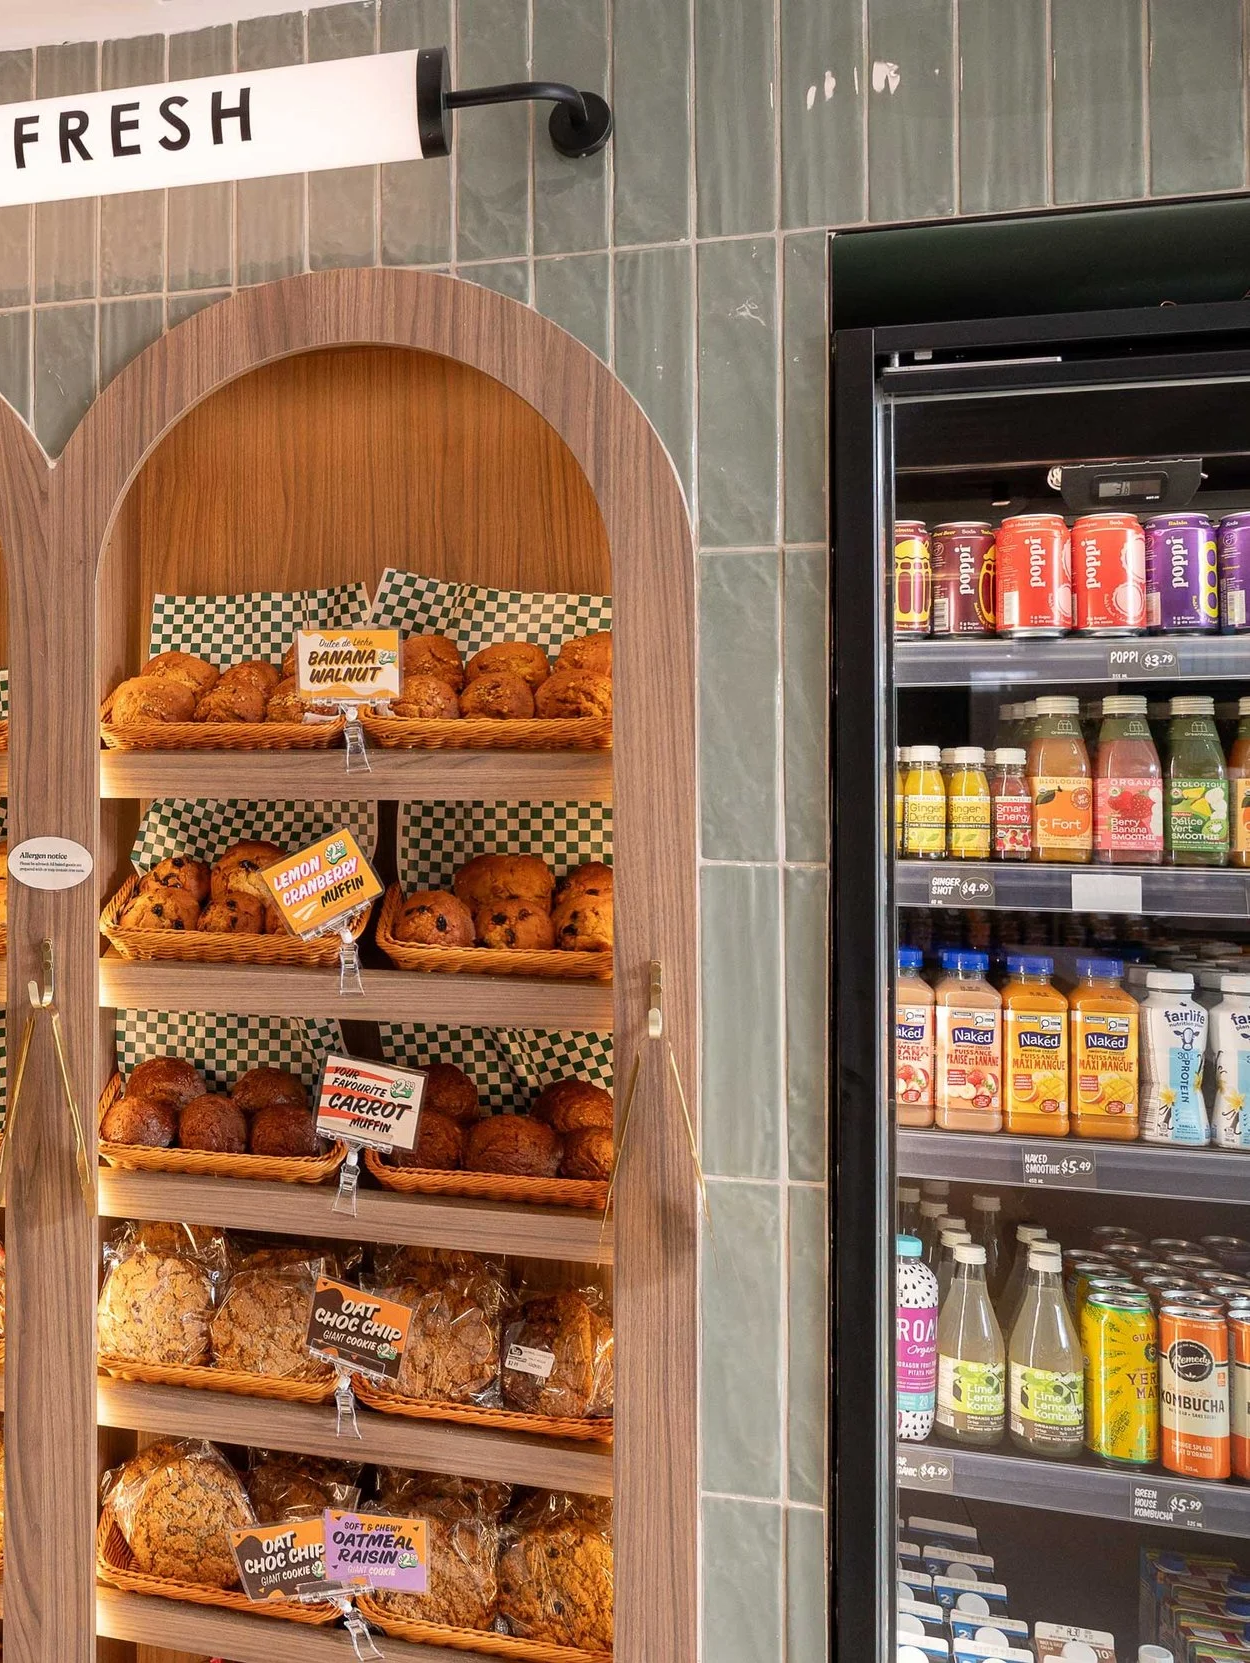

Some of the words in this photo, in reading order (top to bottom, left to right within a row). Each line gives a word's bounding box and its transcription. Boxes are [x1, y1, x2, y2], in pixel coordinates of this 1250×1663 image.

[13, 86, 254, 170] FRESH
[954, 544, 974, 595] poppi
[1024, 536, 1046, 588] poppi
[1081, 539, 1101, 589] poppi
[1166, 536, 1189, 588] poppi
[319, 638, 340, 648] Dulce
[341, 638, 351, 648] de
[307, 649, 377, 666] BANANA
[1110, 650, 1138, 663] POPPI
[1144, 654, 1173, 667] $3.79
[309, 667, 382, 683] WALNUT
[1110, 779, 1162, 787] ORGANIC
[1171, 780, 1226, 789] BIOLOGIQUE
[910, 803, 943, 814] Ginger
[996, 803, 1027, 812] Smart
[910, 813, 945, 822] Defenc
[996, 813, 1030, 824] Energy
[1037, 818, 1048, 829] C
[1052, 818, 1081, 830] Fort
[1111, 817, 1140, 827] Berry
[1171, 816, 1203, 826] Délice
[1111, 825, 1147, 834] Banana
[1111, 833, 1157, 841] SMOOTHIE
[1171, 825, 1193, 833] Vert
[19, 851, 47, 860] Allergen
[47, 852, 68, 860] notice
[273, 855, 321, 891] LEMON
[282, 856, 358, 907] CRANBERRY
[931, 877, 961, 887] GINGER
[961, 881, 989, 895] $4.99
[320, 875, 365, 908] MUFFIN
[931, 886, 953, 895] SHOT
[1164, 1009, 1205, 1025] fairlife
[333, 1066, 360, 1080] YOUR
[1012, 1059, 1033, 1069] MAXI
[1034, 1060, 1066, 1071] MANGUE
[1079, 1059, 1099, 1070] MAXI
[1100, 1061, 1134, 1072] MANGUE
[332, 1077, 388, 1098] FAVOURITE
[1179, 1060, 1191, 1104] PROTEIN
[328, 1093, 413, 1121] CARROT
[349, 1116, 392, 1133] MUFFIN
[1024, 1154, 1048, 1164] NAKED
[1061, 1158, 1091, 1174] $5.49
[1025, 1164, 1060, 1174] SMOOTHIE
[341, 1300, 381, 1319] OAT
[315, 1307, 360, 1332] CHOC
[361, 1319, 402, 1342] CHIP
[897, 1317, 938, 1342] ROA
[323, 1329, 346, 1342] GIANT
[346, 1335, 378, 1351] COOKIE
[1171, 1352, 1212, 1368] Remedy
[1126, 1372, 1157, 1386] YER
[967, 1384, 993, 1393] Lime
[1034, 1391, 1062, 1402] Lime
[1161, 1389, 1225, 1413] KOMBUCHA
[920, 1463, 948, 1478] $4.99
[1134, 1488, 1157, 1499] GREEN
[1134, 1498, 1158, 1509] HOUSE
[1170, 1496, 1202, 1512] $5.99
[1134, 1507, 1174, 1521] KOMBUCHA
[344, 1521, 364, 1531] SOFT
[367, 1523, 373, 1531] &
[373, 1524, 403, 1533] CHEWY
[261, 1530, 296, 1554] OAT
[332, 1531, 415, 1551] OATMEAL
[244, 1552, 286, 1574] CHOC
[289, 1543, 325, 1563] CHIP
[337, 1548, 398, 1565] RAISIN
[260, 1572, 282, 1587] GIANT
[282, 1565, 311, 1580] COOKIE
[347, 1565, 367, 1575] GIANT
[368, 1566, 397, 1577] COOKIE
